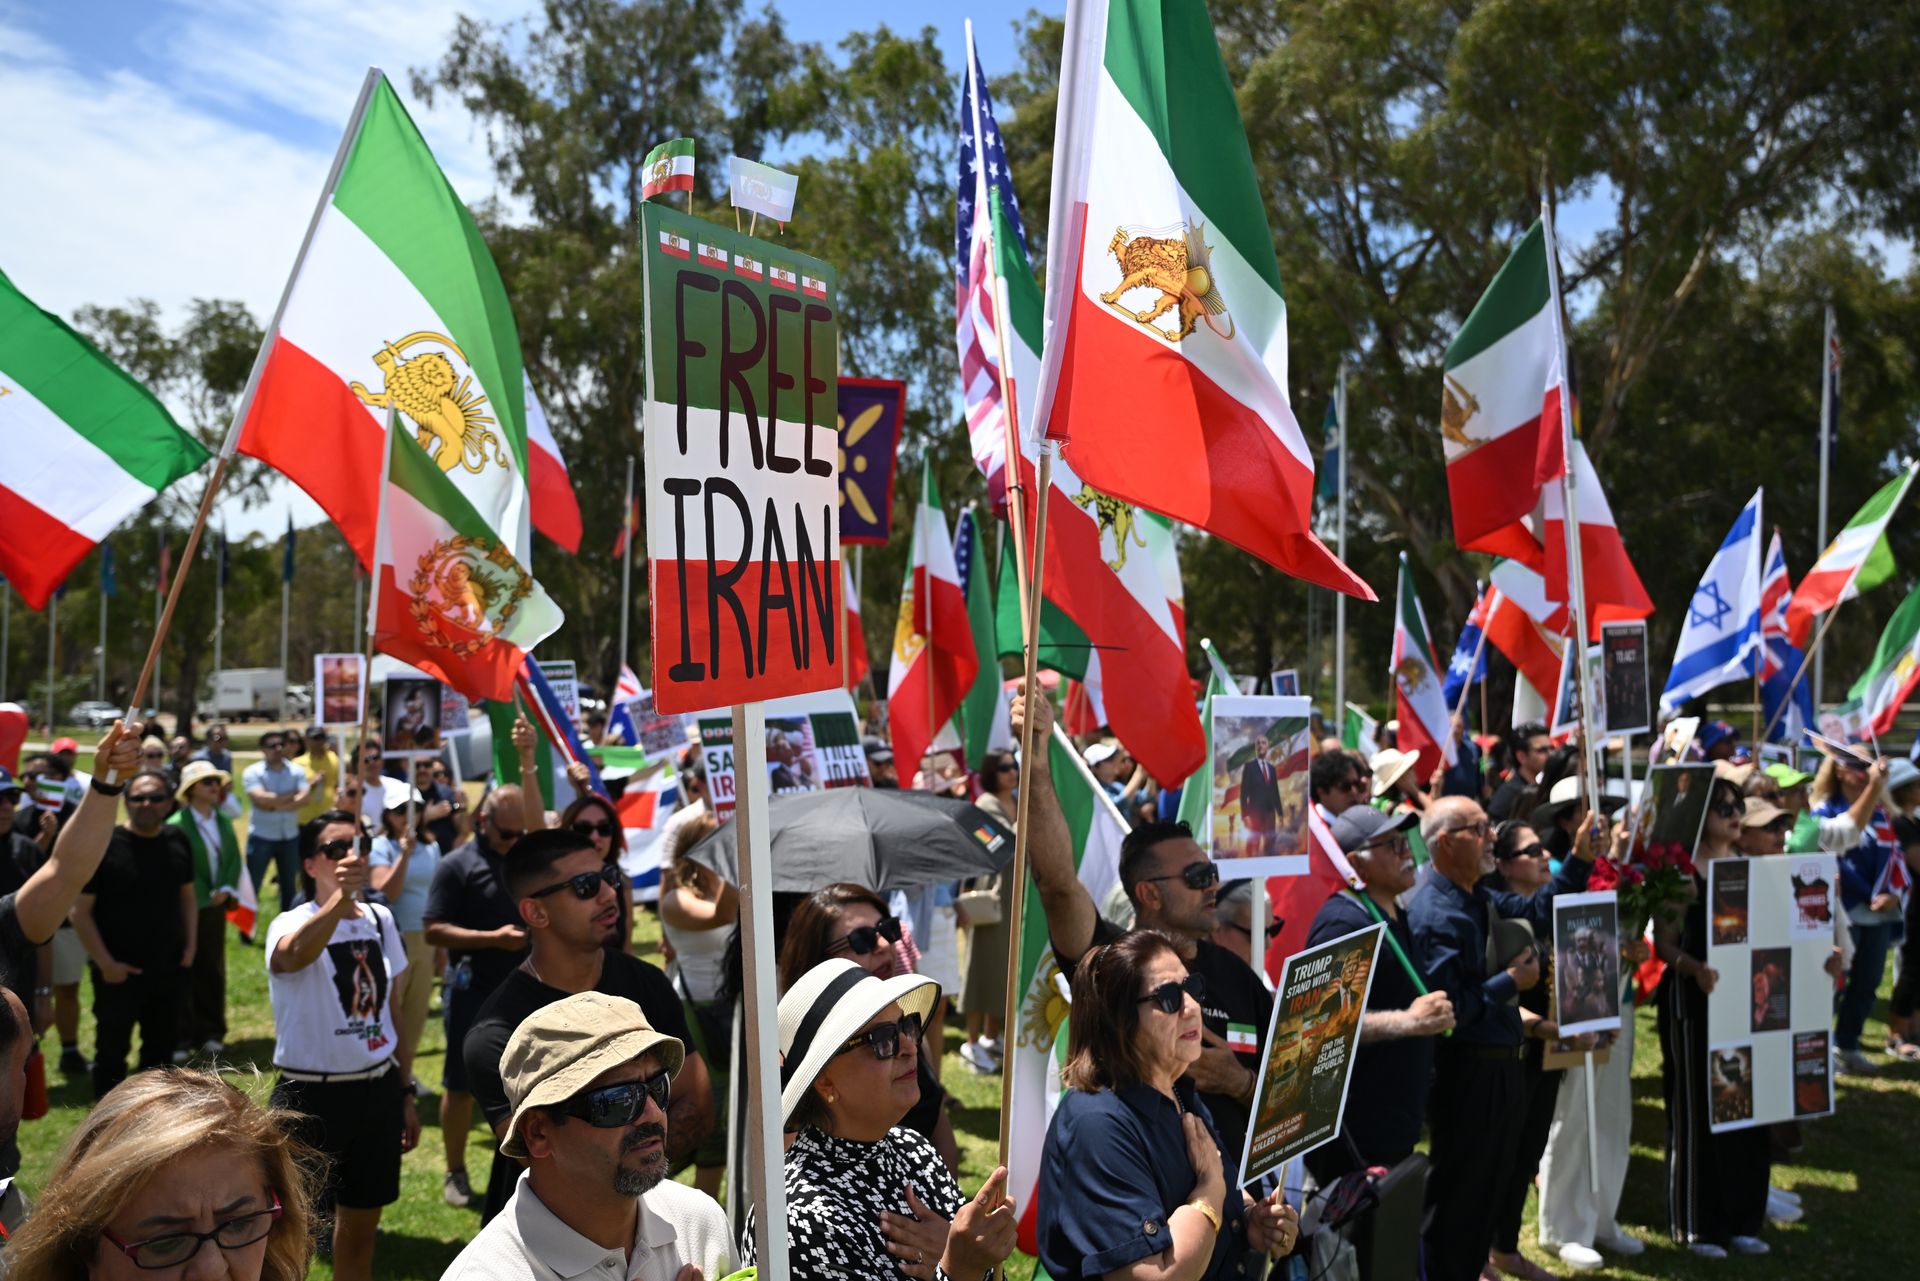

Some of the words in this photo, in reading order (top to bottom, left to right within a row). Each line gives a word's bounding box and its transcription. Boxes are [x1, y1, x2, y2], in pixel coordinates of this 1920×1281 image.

[677, 269, 832, 477] FREE
[663, 477, 834, 682] IRAN
[707, 750, 735, 774] SA
[713, 775, 735, 798] IR
[1294, 955, 1333, 983] TRUMP
[1286, 980, 1311, 999] STAND
[1312, 971, 1331, 988] WITH
[1289, 987, 1321, 1014] IRAN
[1317, 1044, 1345, 1065] ISLAMIC
[1321, 1040, 1334, 1053] END
[1334, 1035, 1345, 1048] THE
[1312, 1053, 1345, 1076] REPUBLIC
[1252, 1135, 1277, 1154] KILLED
[1276, 1131, 1287, 1140] ACT
[1254, 1123, 1284, 1143] REMEMBER
[1252, 1152, 1275, 1170] SUPPORT
[1275, 1147, 1284, 1157] THE
[1284, 1138, 1303, 1152] IRANIAN
[1303, 1124, 1331, 1142] REVOLUTION
